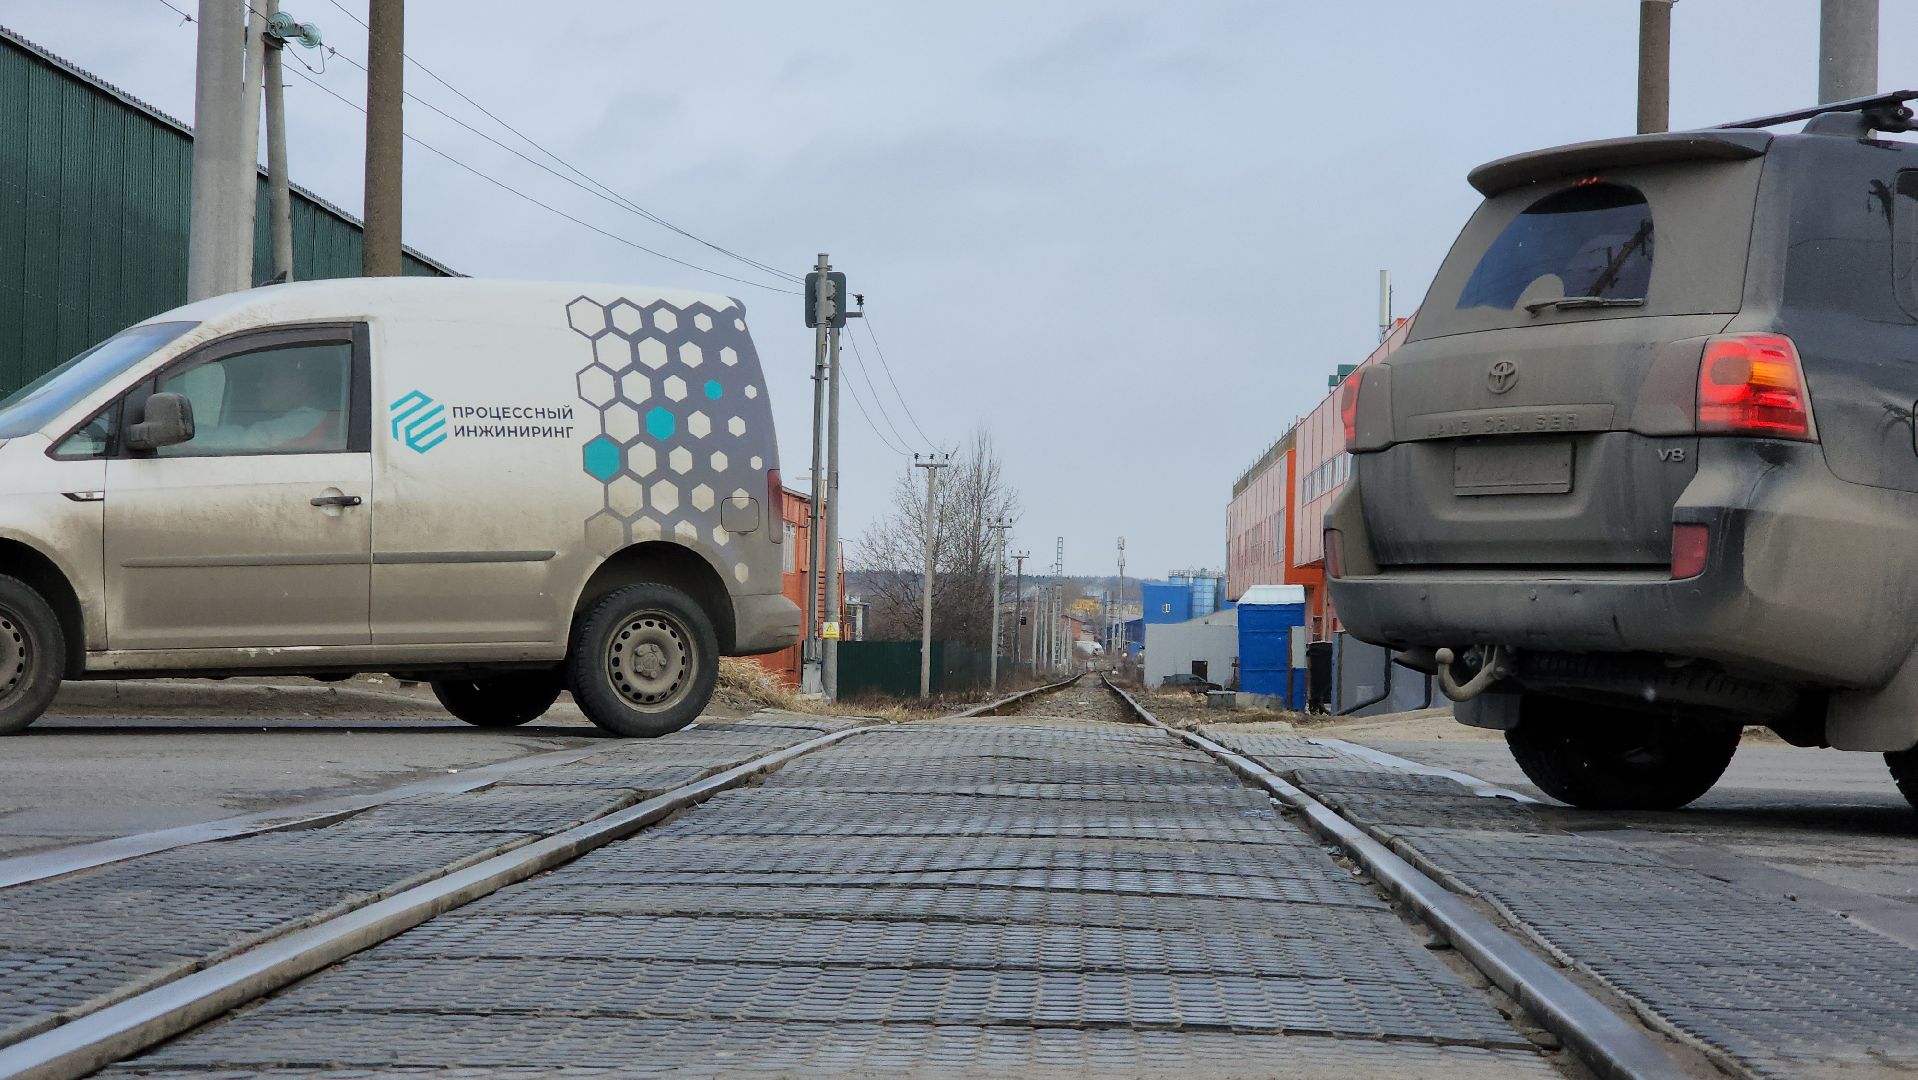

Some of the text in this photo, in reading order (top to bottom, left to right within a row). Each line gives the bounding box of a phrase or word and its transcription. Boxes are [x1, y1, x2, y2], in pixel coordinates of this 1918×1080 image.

[452, 404, 573, 420] ПРОЦЕССНЫЙ
[454, 425, 574, 438] ИНЖИНИРИНГ
[1427, 420, 1471, 438] LAND
[1656, 447, 1686, 462] V8
